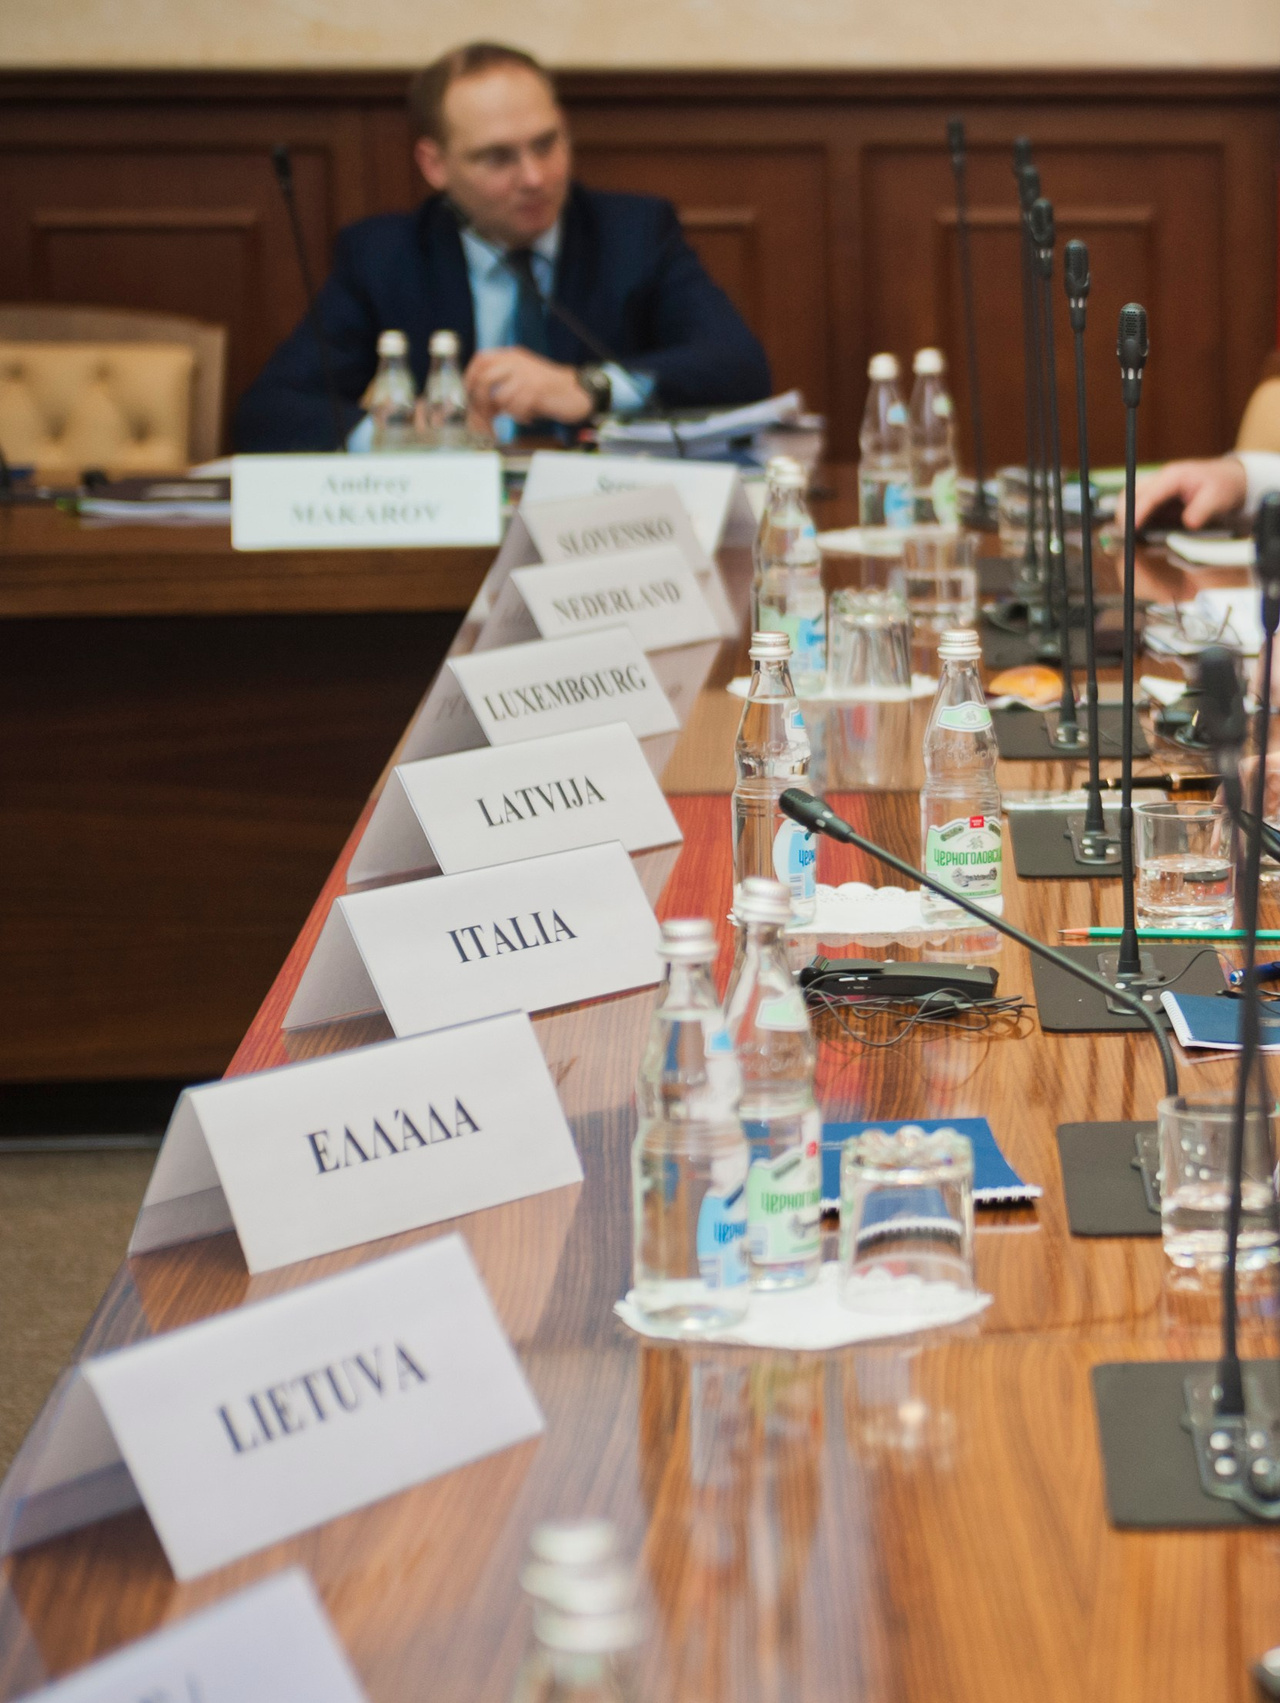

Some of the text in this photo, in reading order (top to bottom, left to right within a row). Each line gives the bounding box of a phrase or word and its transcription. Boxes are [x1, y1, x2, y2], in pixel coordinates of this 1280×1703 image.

[557, 516, 675, 556] SLOVENSKO
[553, 580, 681, 623] NEDERLAND
[483, 663, 647, 722] LUXEMBOURG
[474, 775, 606, 827] LATVIJA
[446, 908, 579, 964] ITALIA
[303, 1096, 482, 1175] ΕΛΛΆΔΑ
[215, 1342, 430, 1456] LIETUVA
